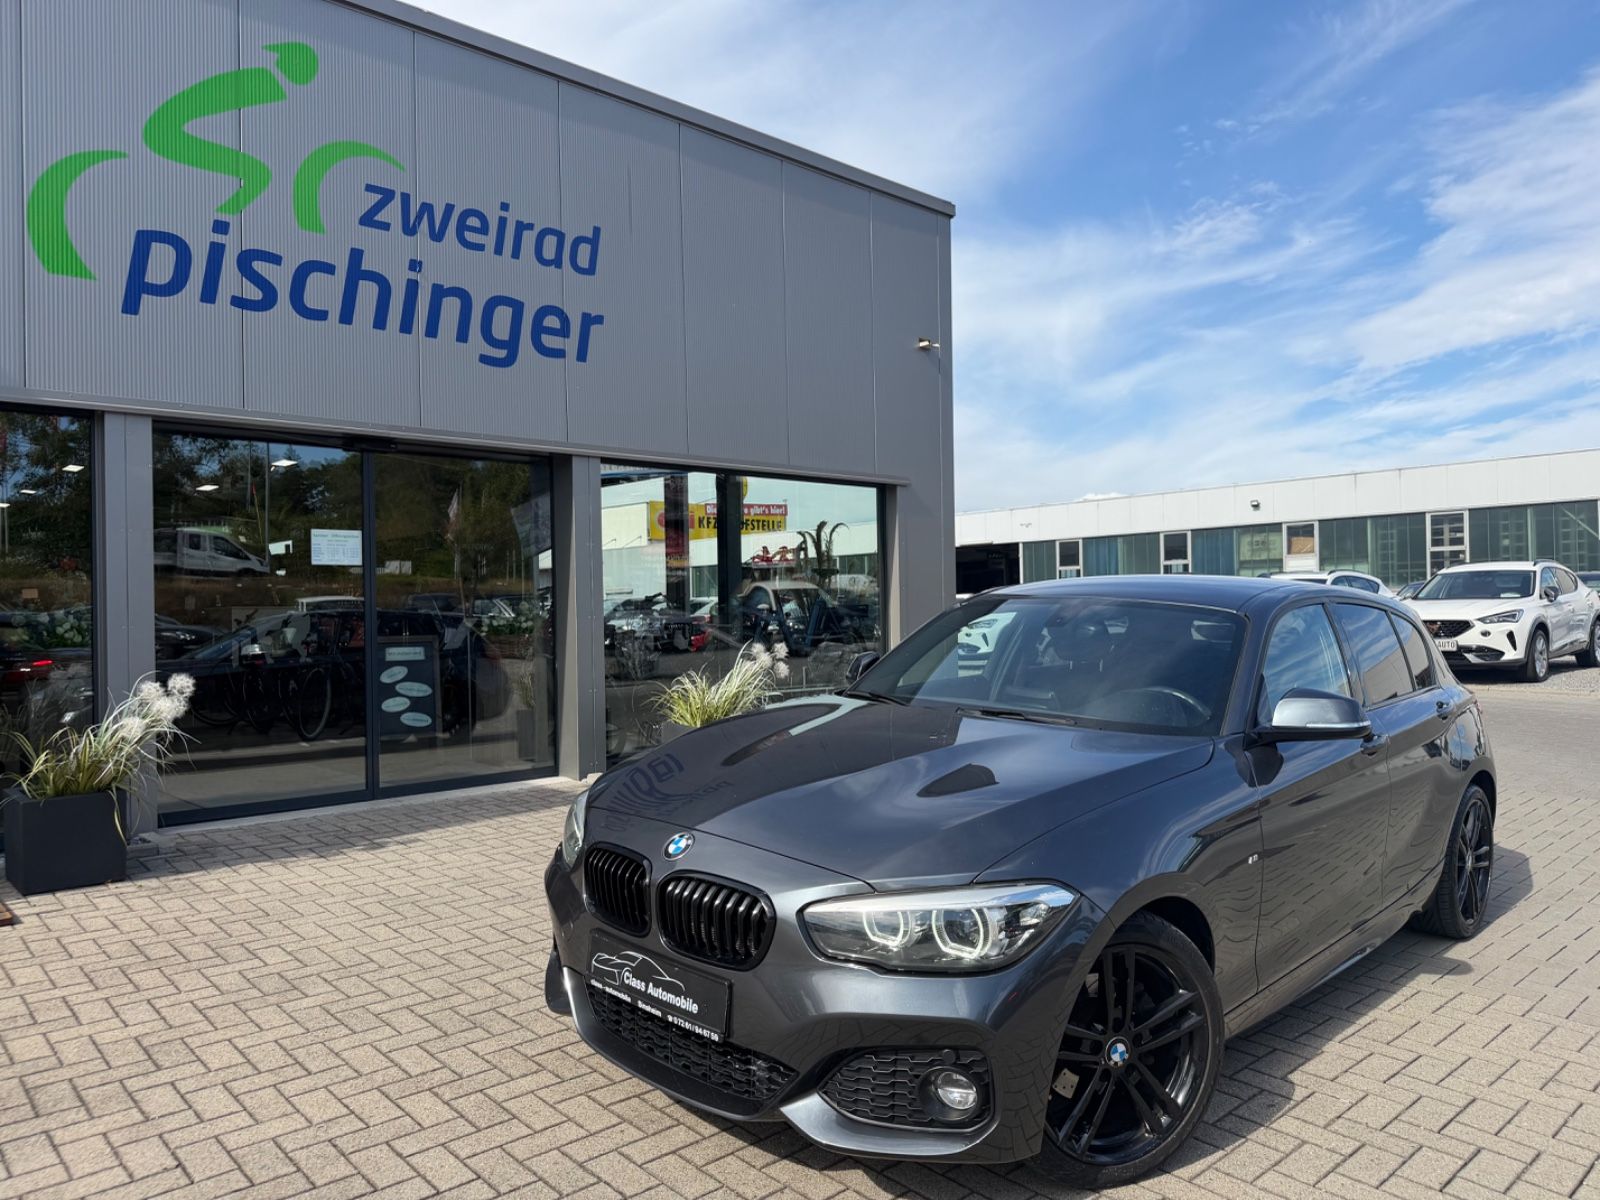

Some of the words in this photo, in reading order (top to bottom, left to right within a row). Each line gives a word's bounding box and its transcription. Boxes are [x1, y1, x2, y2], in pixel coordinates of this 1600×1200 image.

[358, 183, 602, 276] zweirad
[120, 219, 604, 368] pischinger
[751, 505, 769, 516] gibt's
[771, 505, 785, 514] hier!
[623, 970, 646, 992] Class
[647, 982, 699, 1015] Automobile
